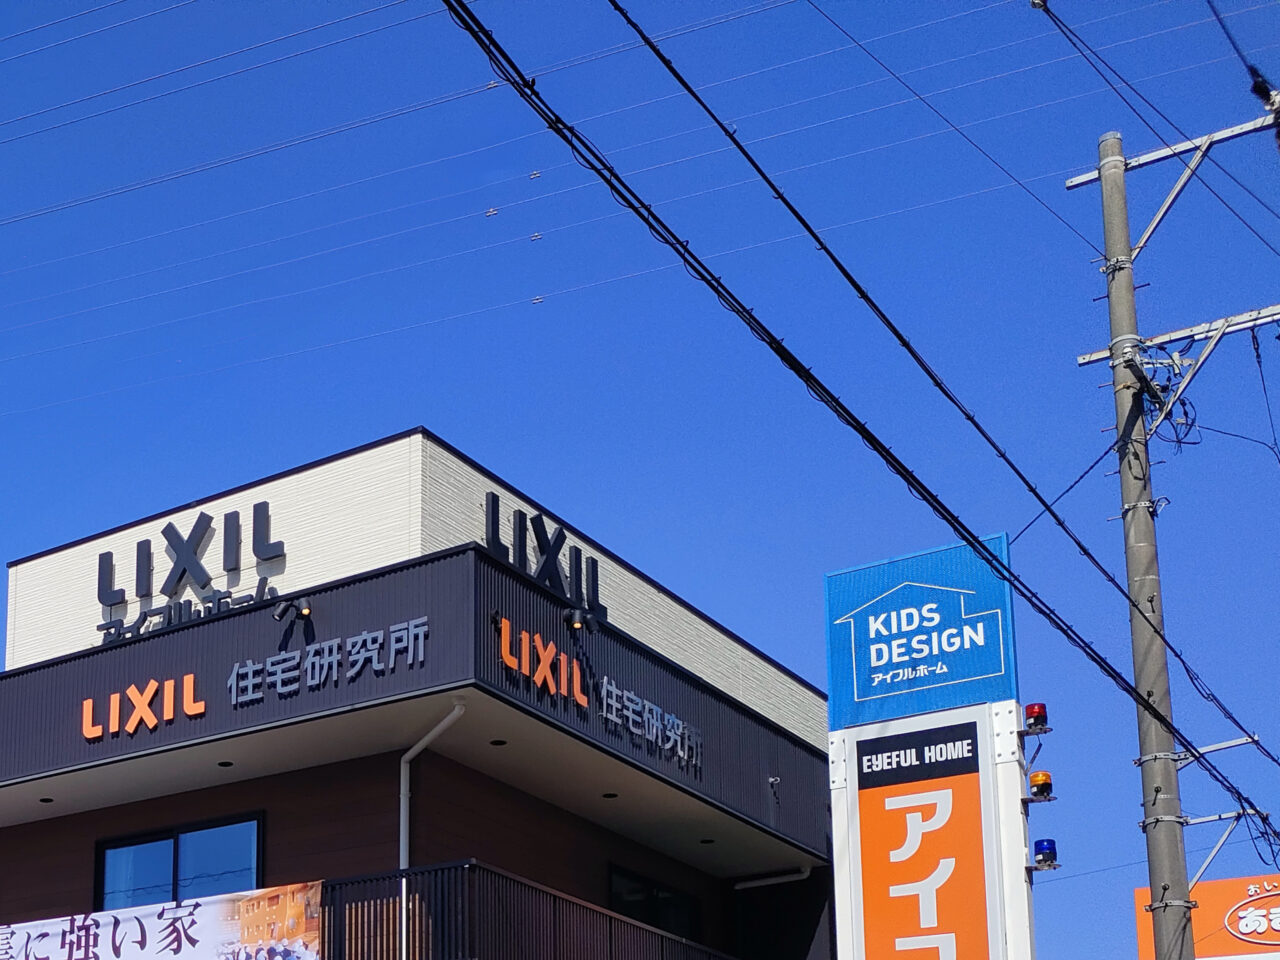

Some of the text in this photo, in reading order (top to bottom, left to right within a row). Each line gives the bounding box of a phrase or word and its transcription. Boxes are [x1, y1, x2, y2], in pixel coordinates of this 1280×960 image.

[98, 500, 285, 608] LIXIL
[485, 491, 607, 621] LIXIL
[868, 603, 941, 639] KIDS
[870, 622, 985, 667] DESIGN
[82, 616, 430, 740] LIXIL 住宅研究所
[500, 617, 703, 766] LIXIL 住宅研究所
[871, 661, 948, 686] アイフルホーム
[862, 739, 973, 773] EYEFUL HOME
